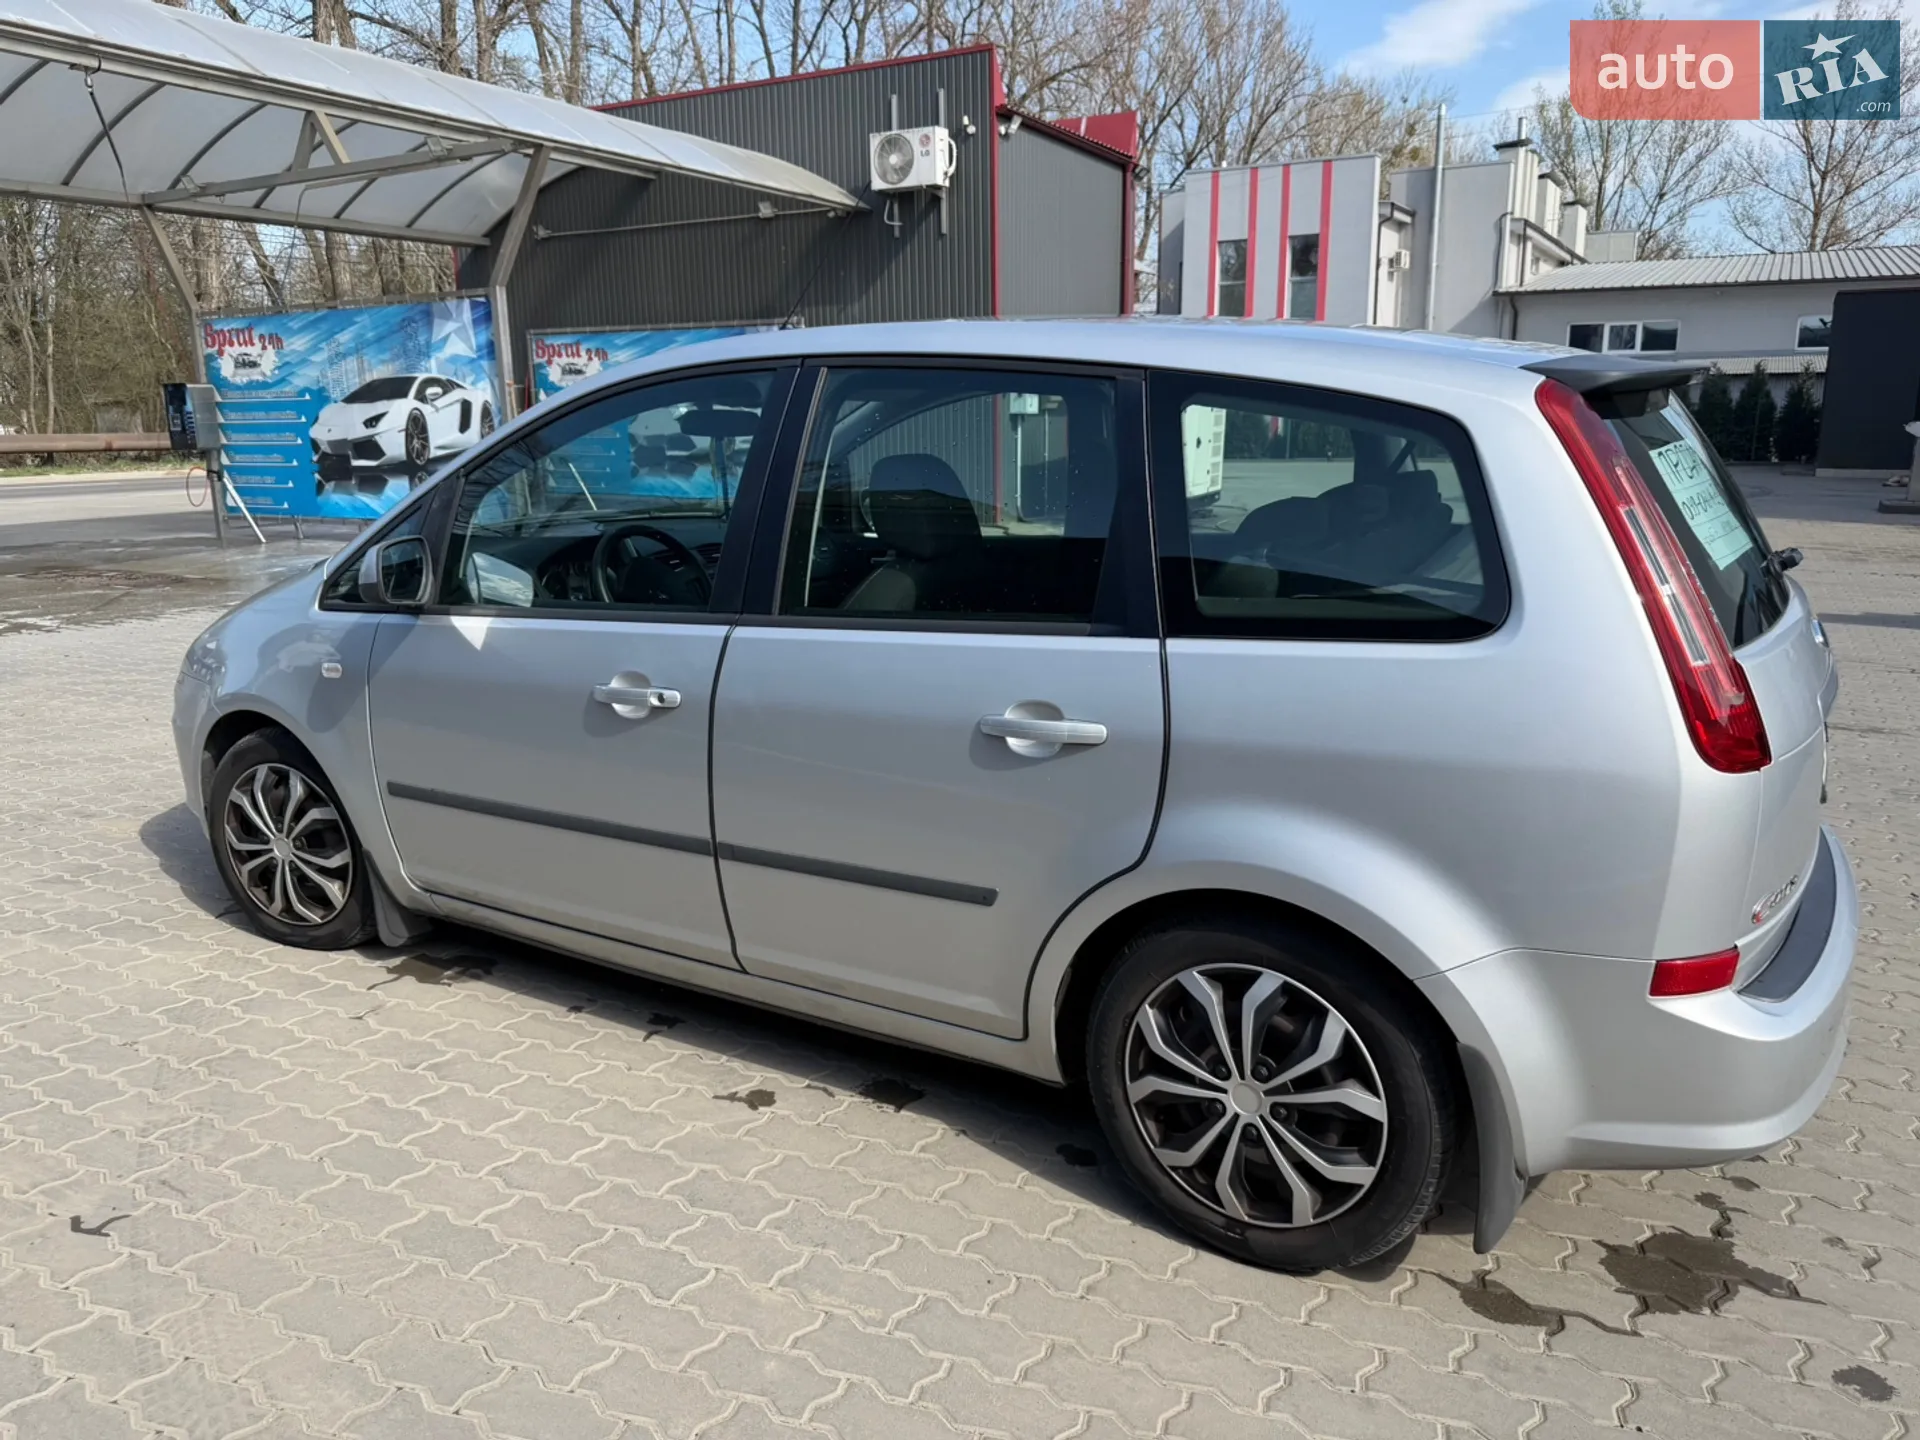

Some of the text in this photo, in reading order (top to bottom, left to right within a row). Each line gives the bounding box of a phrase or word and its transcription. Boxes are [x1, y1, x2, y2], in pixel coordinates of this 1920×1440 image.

[920, 149, 930, 157] LG
[204, 323, 255, 357] Sprut
[535, 339, 582, 366] Sprut
